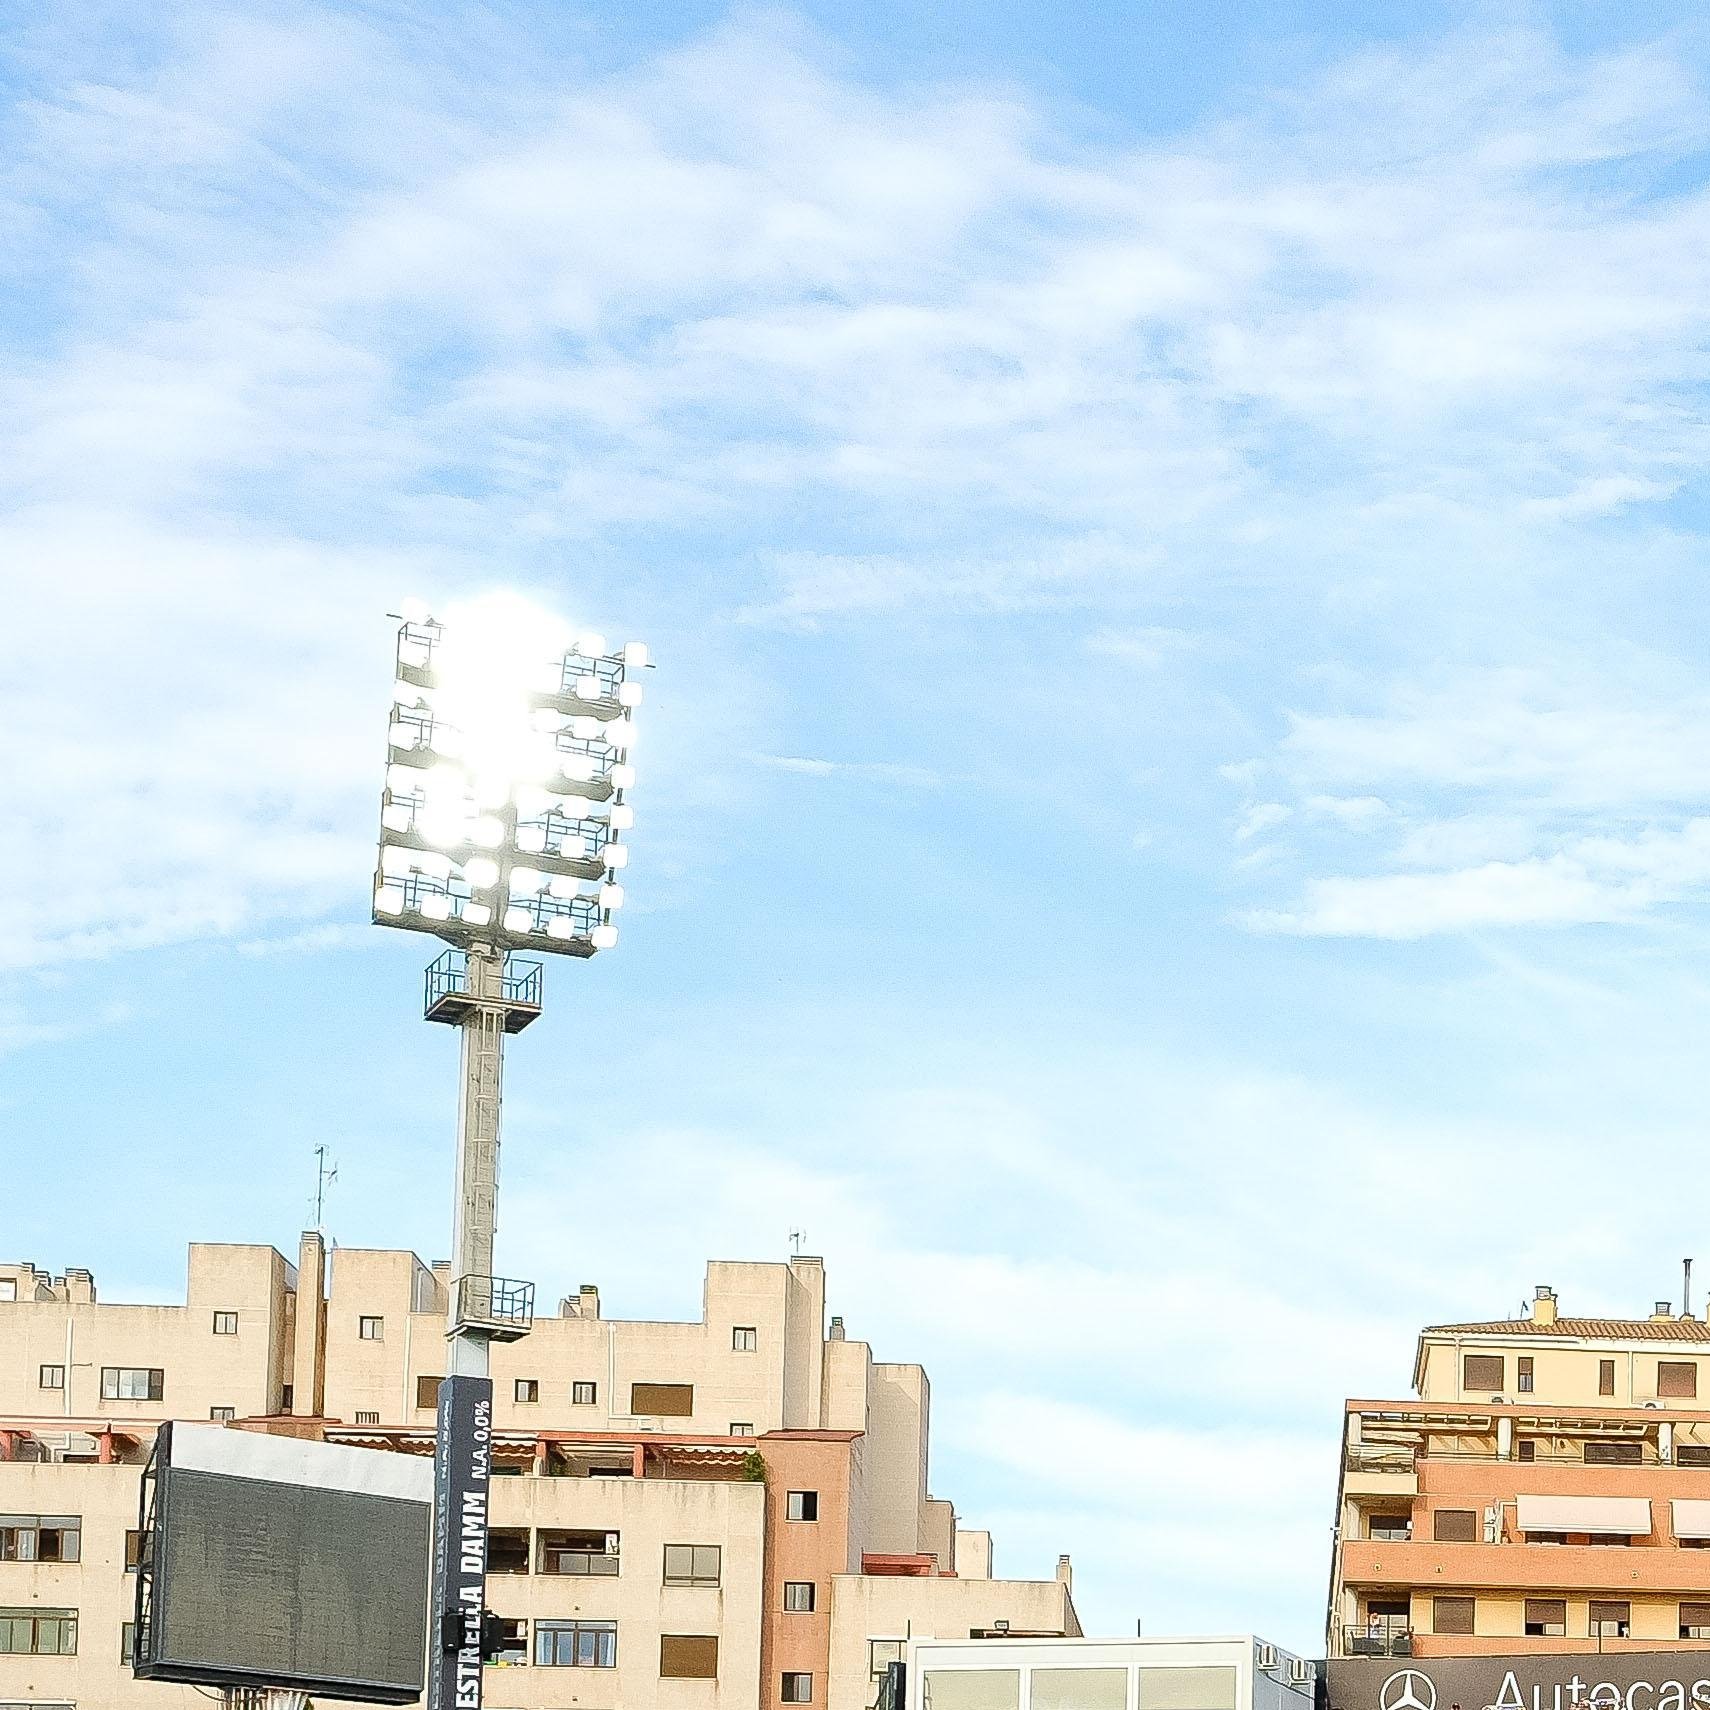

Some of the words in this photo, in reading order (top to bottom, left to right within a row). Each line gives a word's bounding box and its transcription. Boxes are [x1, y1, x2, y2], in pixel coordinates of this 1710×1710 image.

[473, 1400, 491, 1442] 0,0%
[461, 1491, 487, 1574] DAMM
[455, 1585, 482, 1709] ESTRELLA
